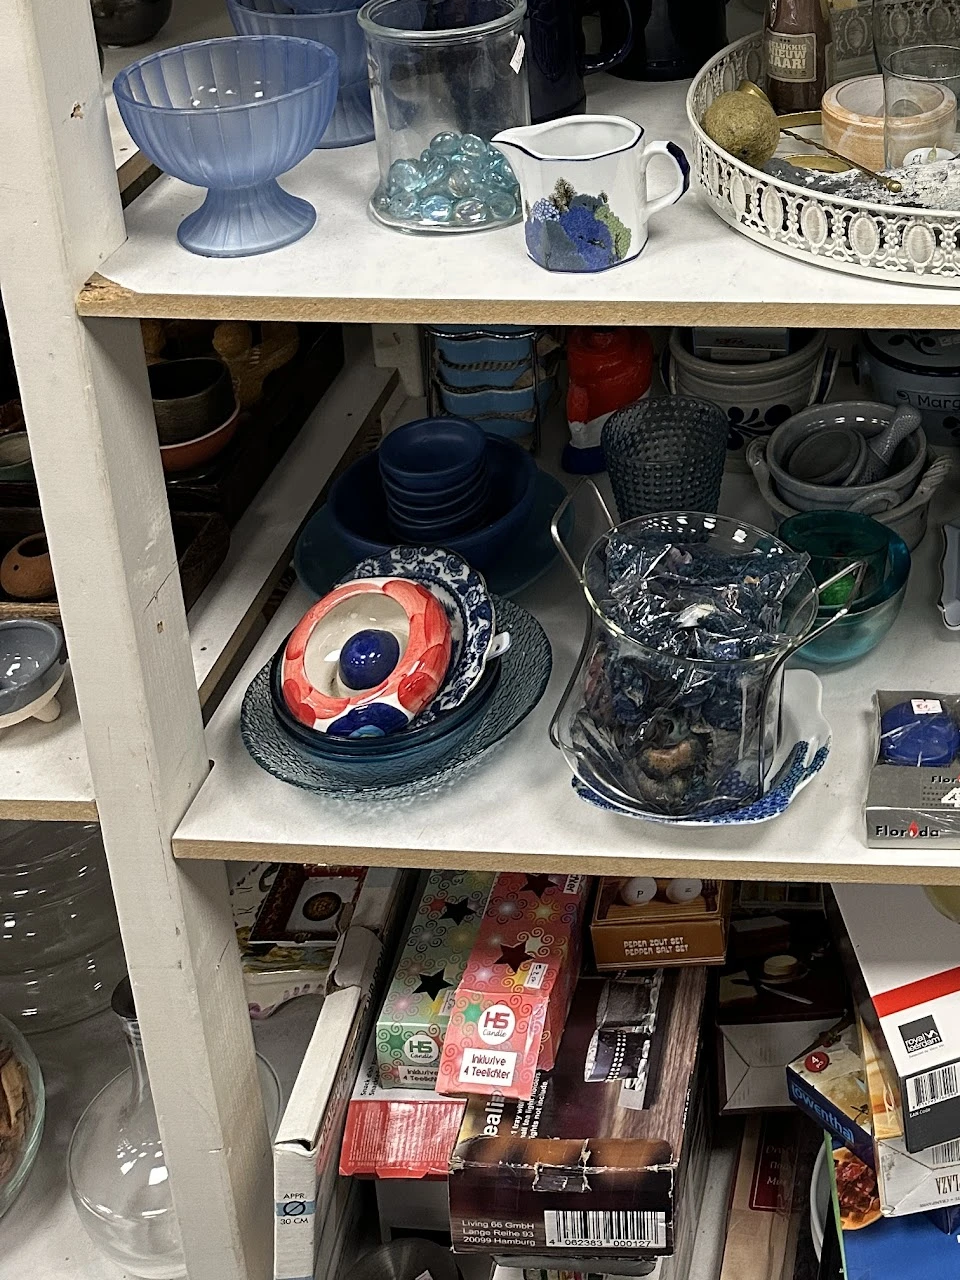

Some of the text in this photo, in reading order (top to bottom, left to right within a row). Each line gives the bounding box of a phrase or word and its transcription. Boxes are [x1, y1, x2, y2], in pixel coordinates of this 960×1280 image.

[636, 890, 644, 899] P
[623, 936, 684, 949] PEPER ZOUT SET
[624, 944, 689, 956] PEPPER SALT SET
[482, 1028, 507, 1039] Candle
[904, 1032, 925, 1046] royal
[463, 1066, 511, 1079] 4 Teelichter
[533, 1107, 543, 1120] not
[918, 1107, 931, 1116] Code
[512, 1115, 523, 1130] tray
[528, 1120, 540, 1139] ights
[293, 1217, 309, 1225] CM
[462, 1220, 489, 1229] Living
[504, 1221, 535, 1230] GmbH
[462, 1228, 534, 1238] Lange Reihe 93
[463, 1236, 536, 1247] 20099 Hamburg
[613, 1240, 651, 1248] 000127
